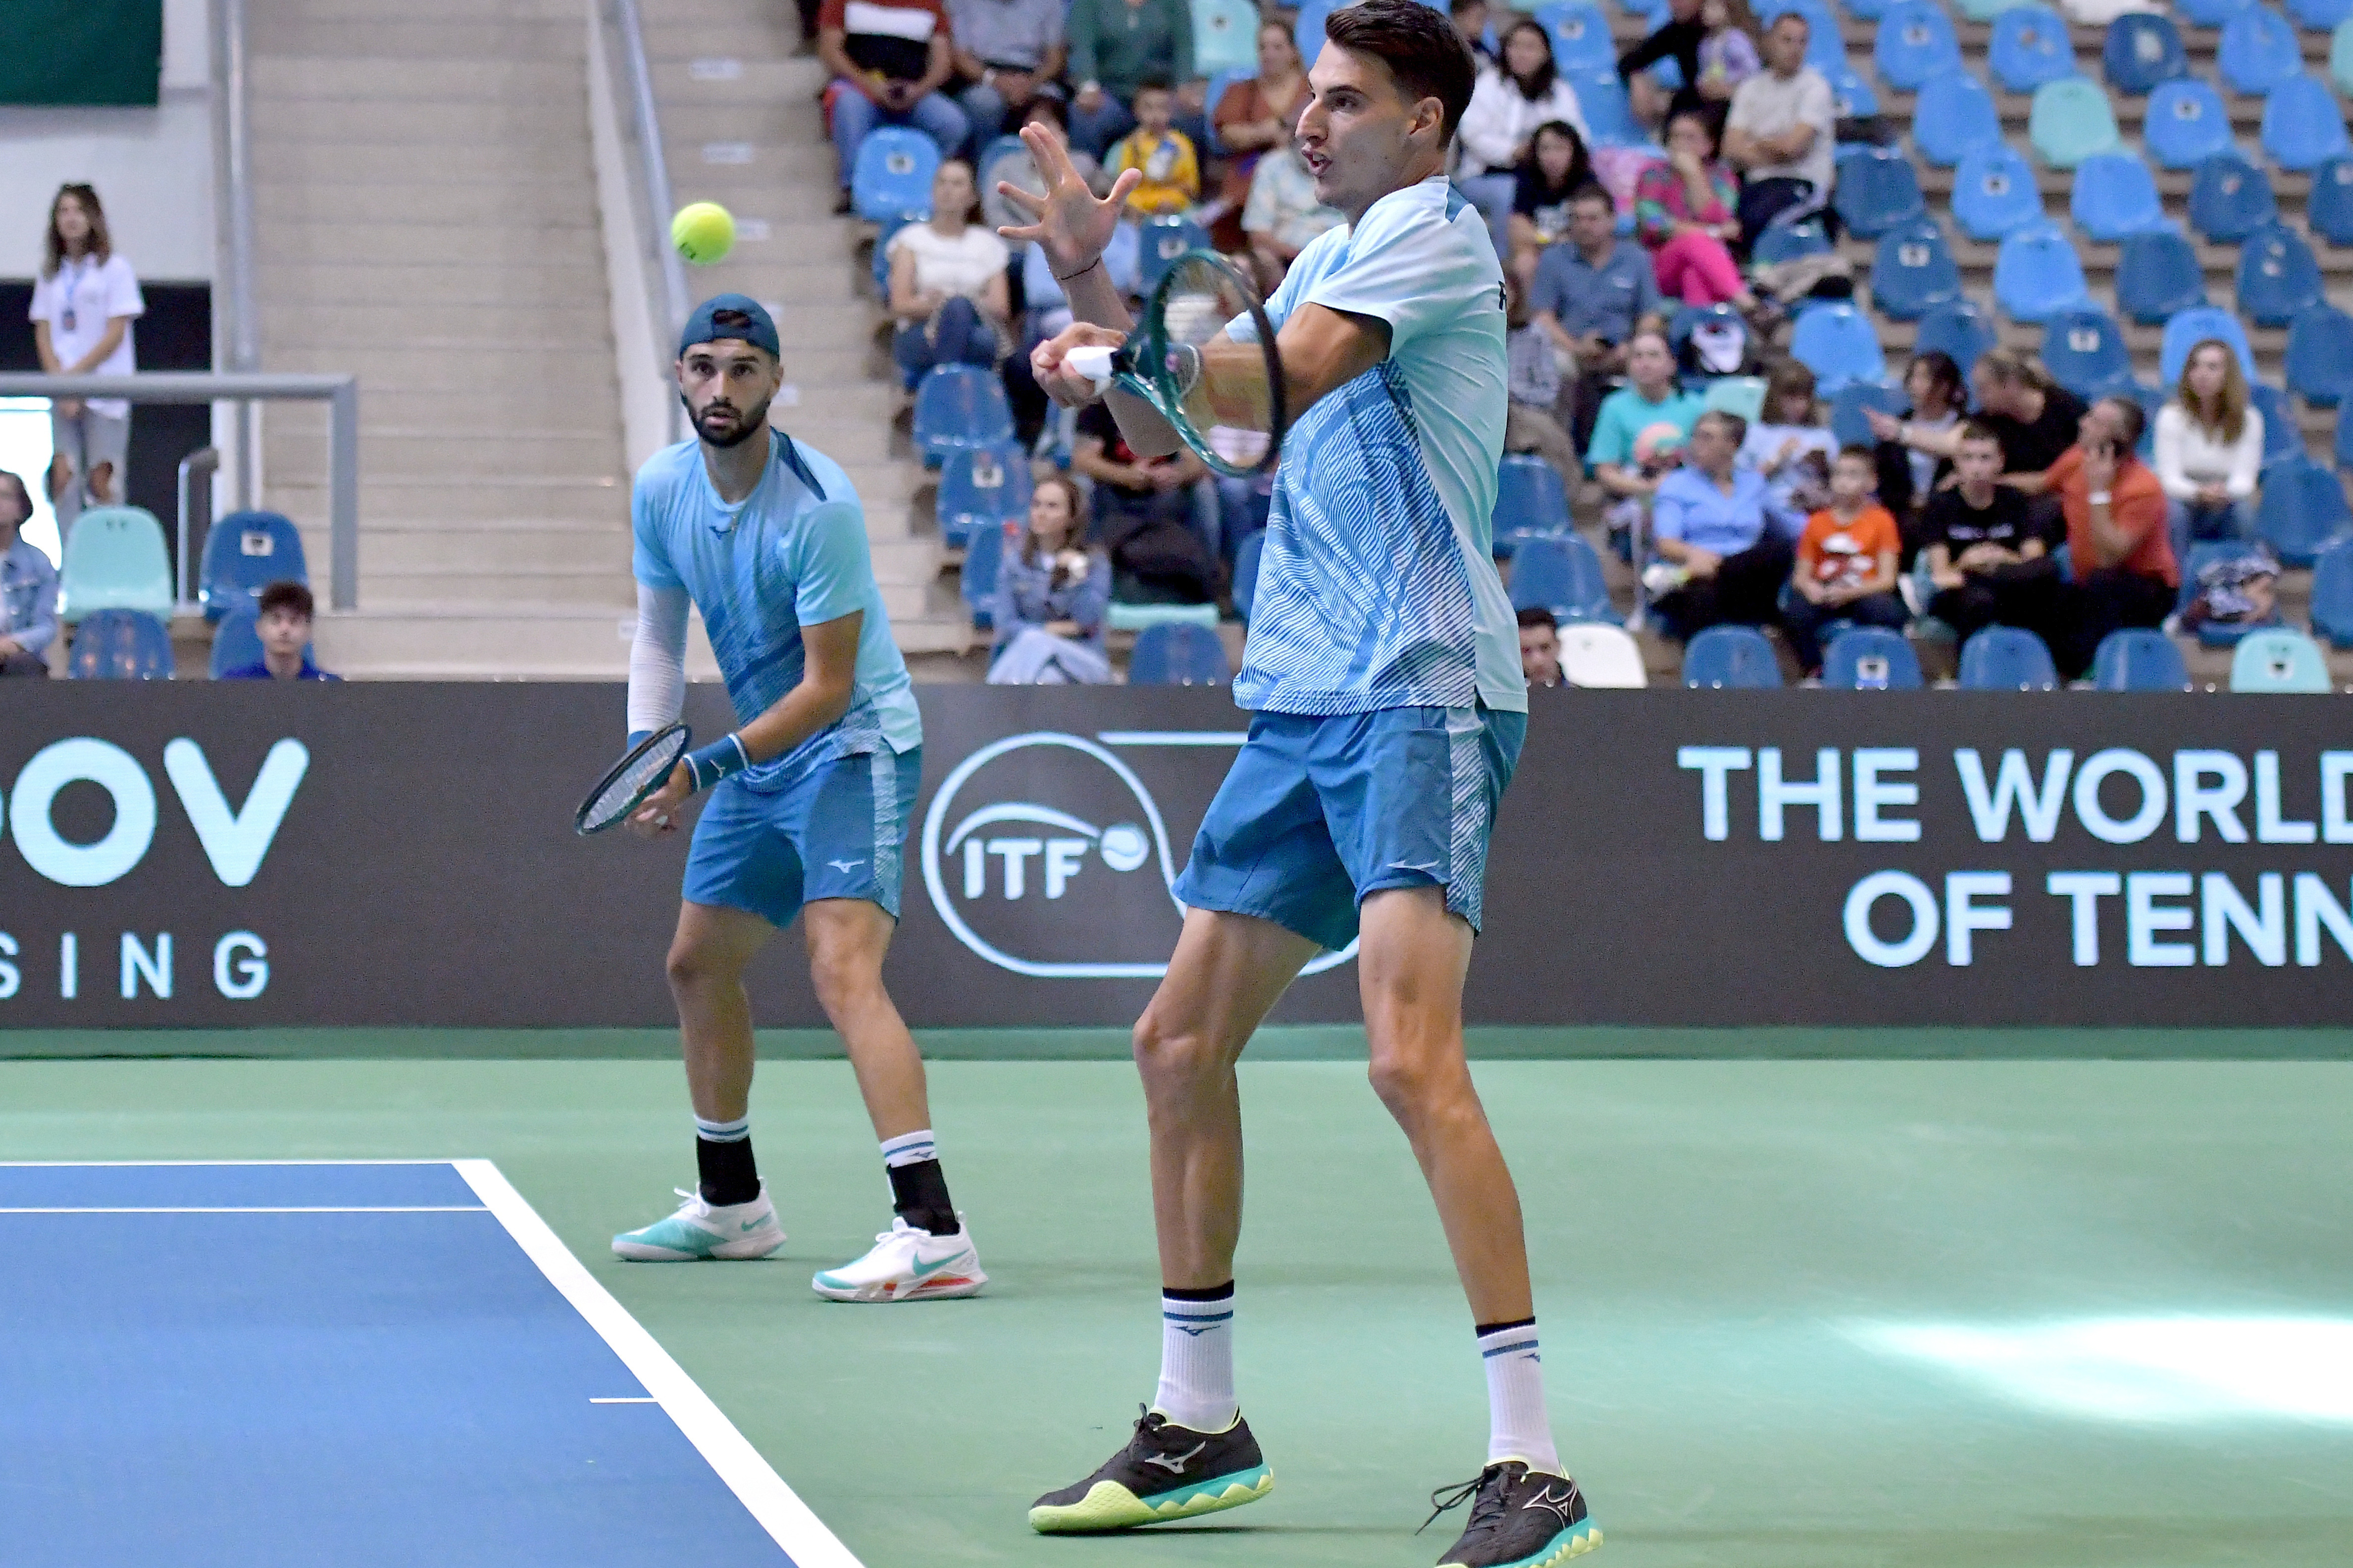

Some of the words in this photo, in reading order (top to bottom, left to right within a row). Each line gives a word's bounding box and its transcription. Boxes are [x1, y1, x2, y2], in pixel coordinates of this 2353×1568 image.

[0, 737, 310, 887] OV
[1677, 746, 1922, 842] THE
[964, 837, 1088, 900] ITF
[1842, 870, 2013, 968] OF
[2046, 872, 2353, 967] TENN
